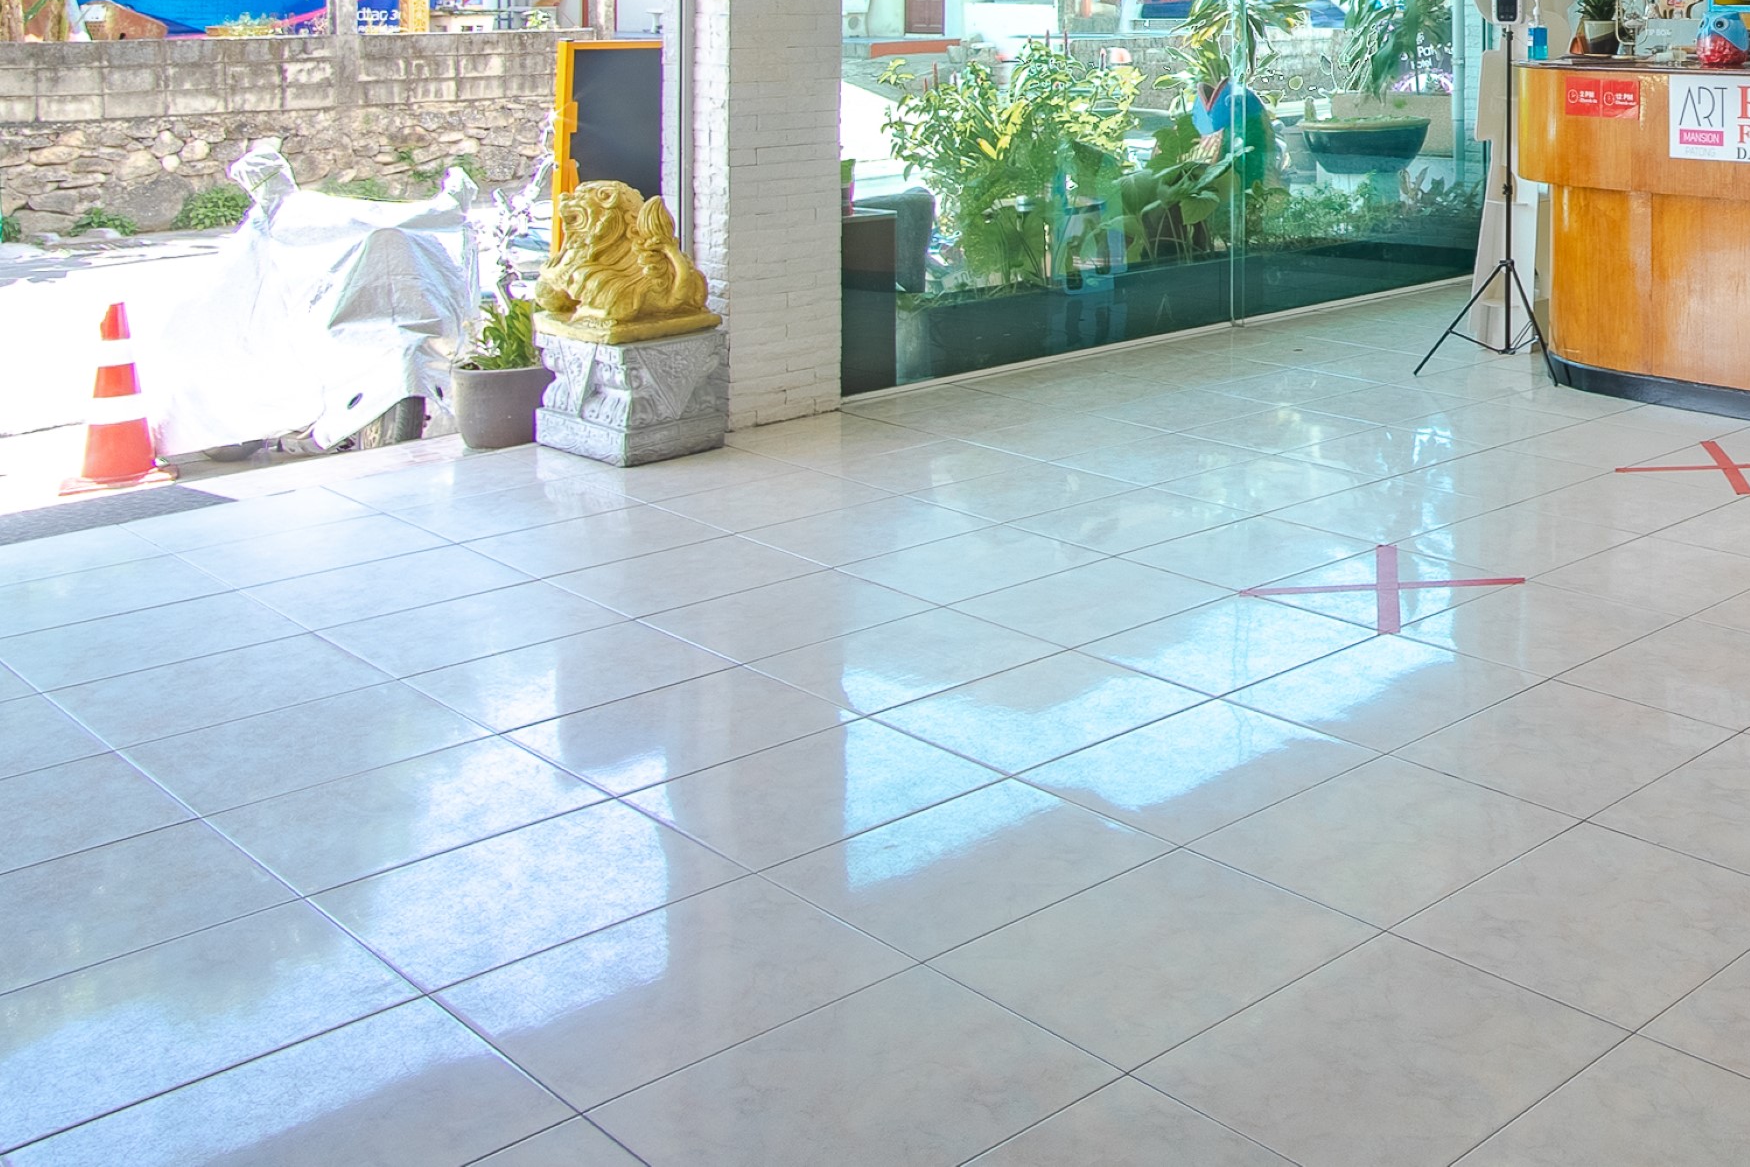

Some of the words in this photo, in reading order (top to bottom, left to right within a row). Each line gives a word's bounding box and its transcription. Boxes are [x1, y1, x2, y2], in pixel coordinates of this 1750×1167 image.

[389, 9, 400, 21] 3
[1679, 86, 1728, 128] ART
[1682, 132, 1720, 143] MANSION
[1684, 147, 1717, 157] PATONG
